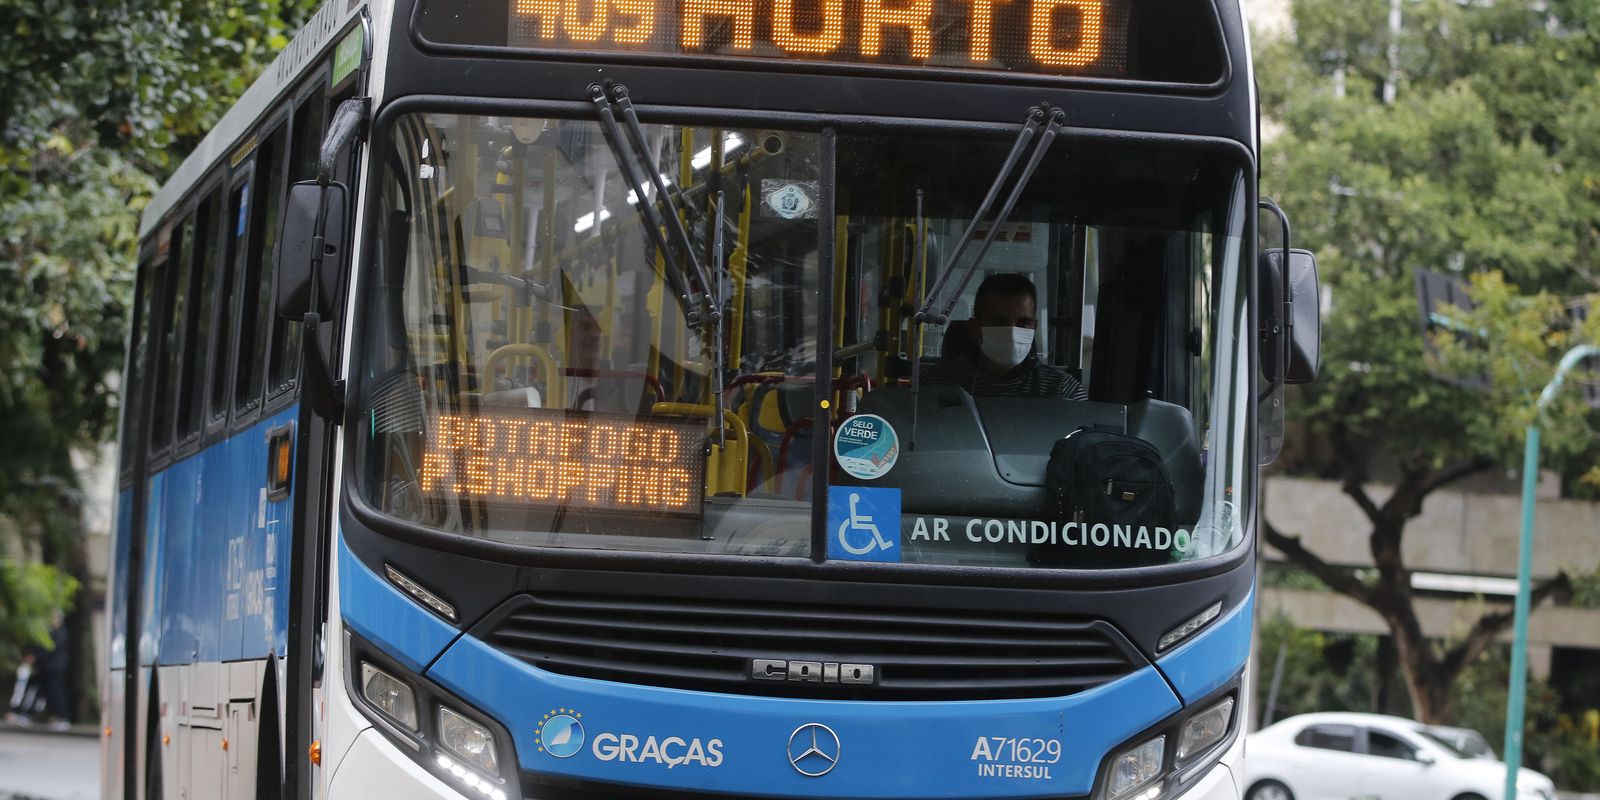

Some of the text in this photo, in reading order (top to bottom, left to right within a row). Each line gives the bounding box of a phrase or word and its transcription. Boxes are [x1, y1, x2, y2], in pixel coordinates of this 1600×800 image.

[438, 414, 679, 463] BOTAFOGO
[844, 426, 879, 440] VERDE
[852, 420, 874, 430] SELO
[421, 452, 690, 507] P.SHOPPING
[911, 517, 1193, 553] AR CONDICIONADO
[752, 658, 875, 685] CAIO
[592, 732, 724, 769] GRAÇAS
[970, 736, 1062, 764] A71629
[978, 763, 1052, 779] INTERSUL
